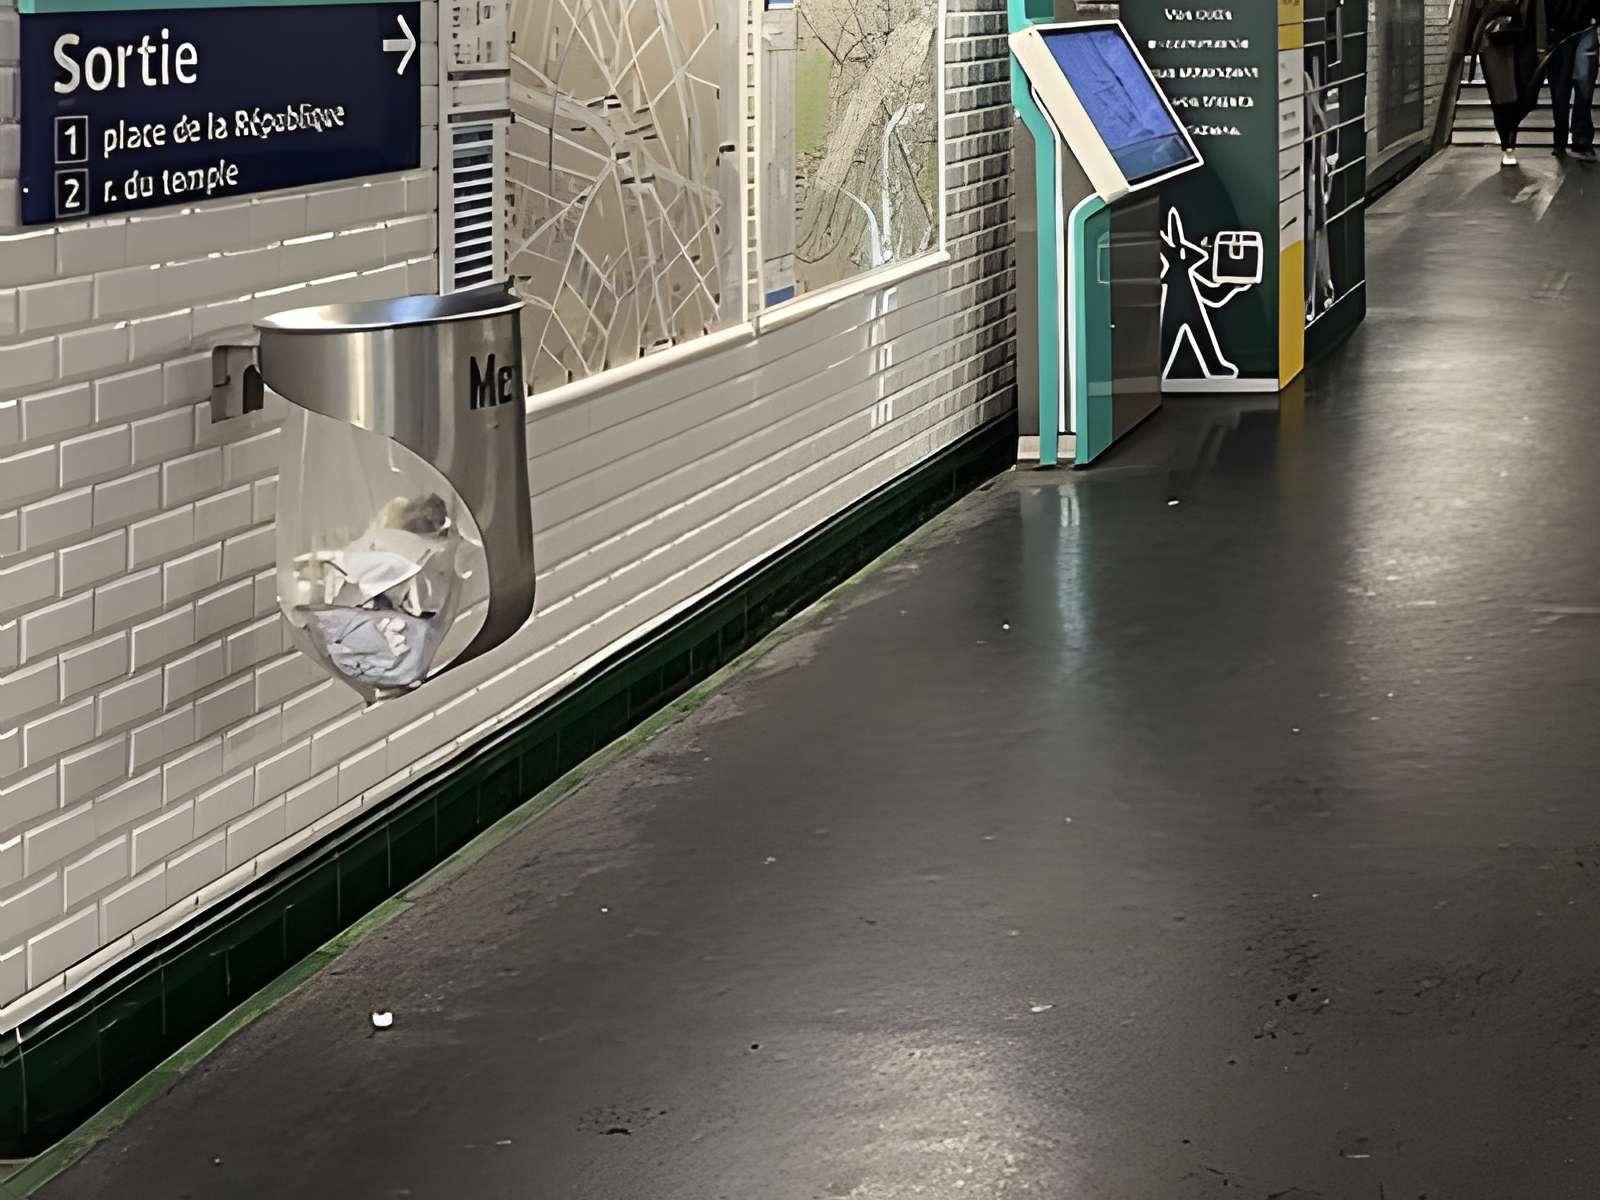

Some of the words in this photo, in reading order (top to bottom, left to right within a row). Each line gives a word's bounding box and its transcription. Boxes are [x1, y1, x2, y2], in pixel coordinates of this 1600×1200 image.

[53, 27, 198, 94] Sortie
[103, 119, 167, 159] place
[172, 113, 201, 144] de
[207, 111, 228, 140] la
[103, 180, 118, 203] r.
[124, 169, 154, 199] du
